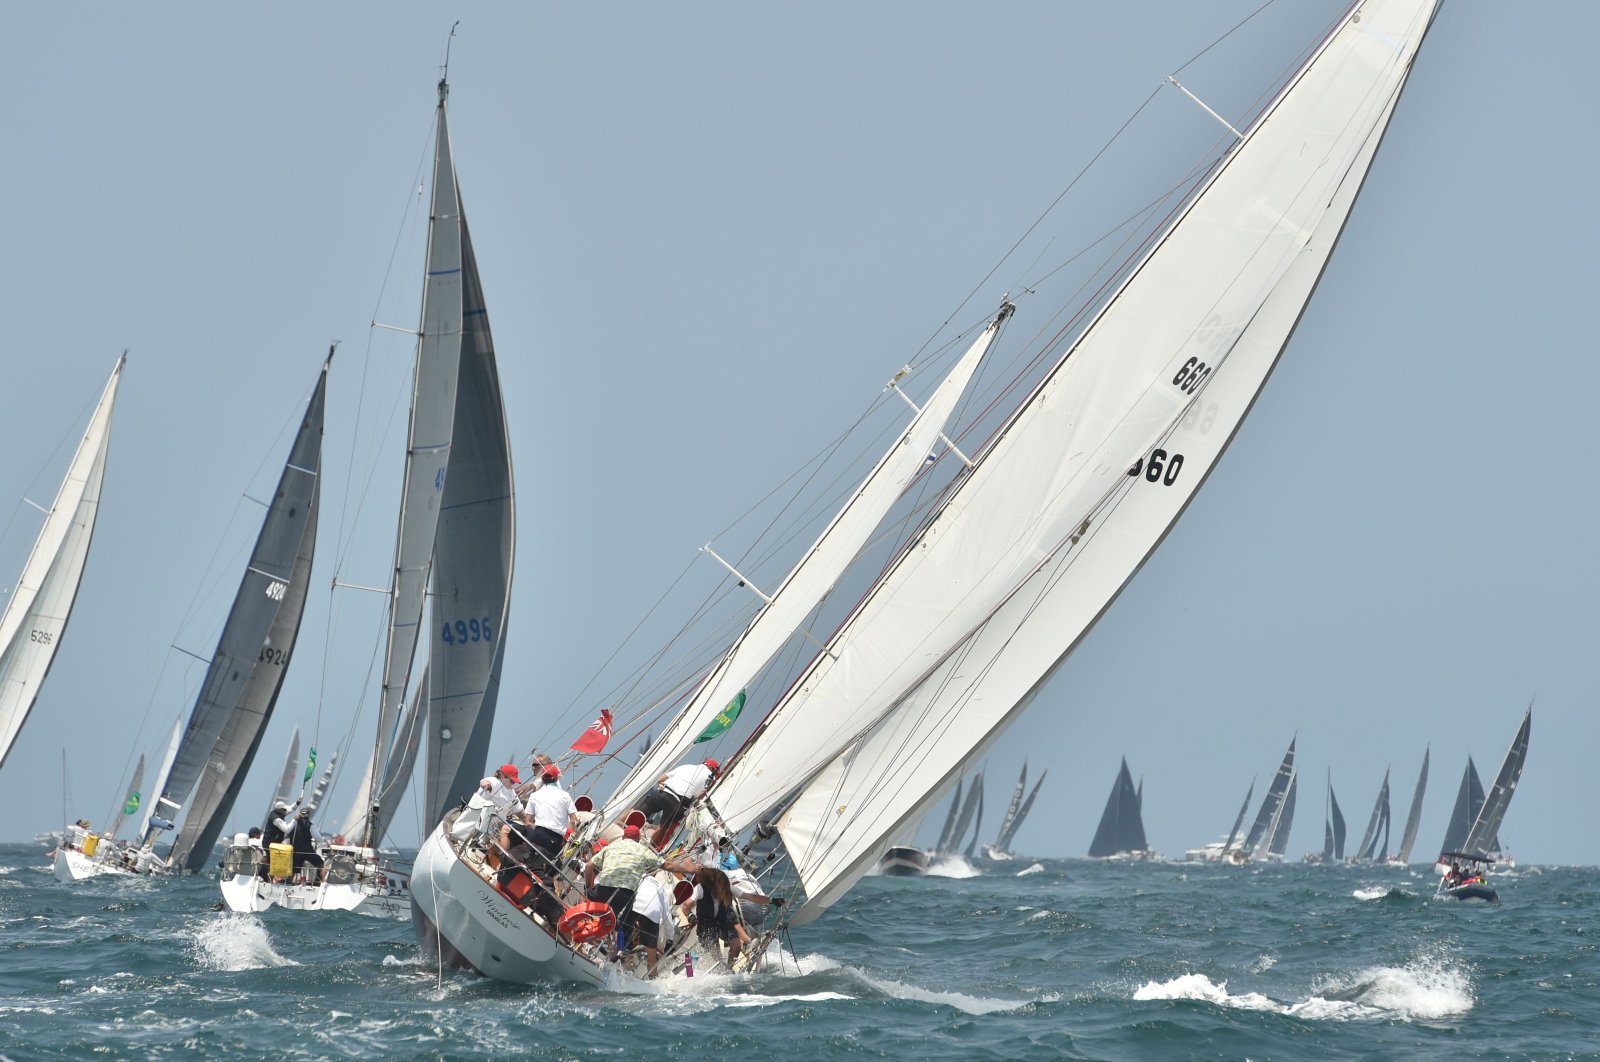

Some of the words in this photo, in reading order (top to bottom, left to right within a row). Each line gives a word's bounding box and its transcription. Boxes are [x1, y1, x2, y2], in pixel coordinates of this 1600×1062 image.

[1172, 356, 1212, 395] 660
[31, 629, 53, 646] 5296
[442, 616, 492, 645] 4996
